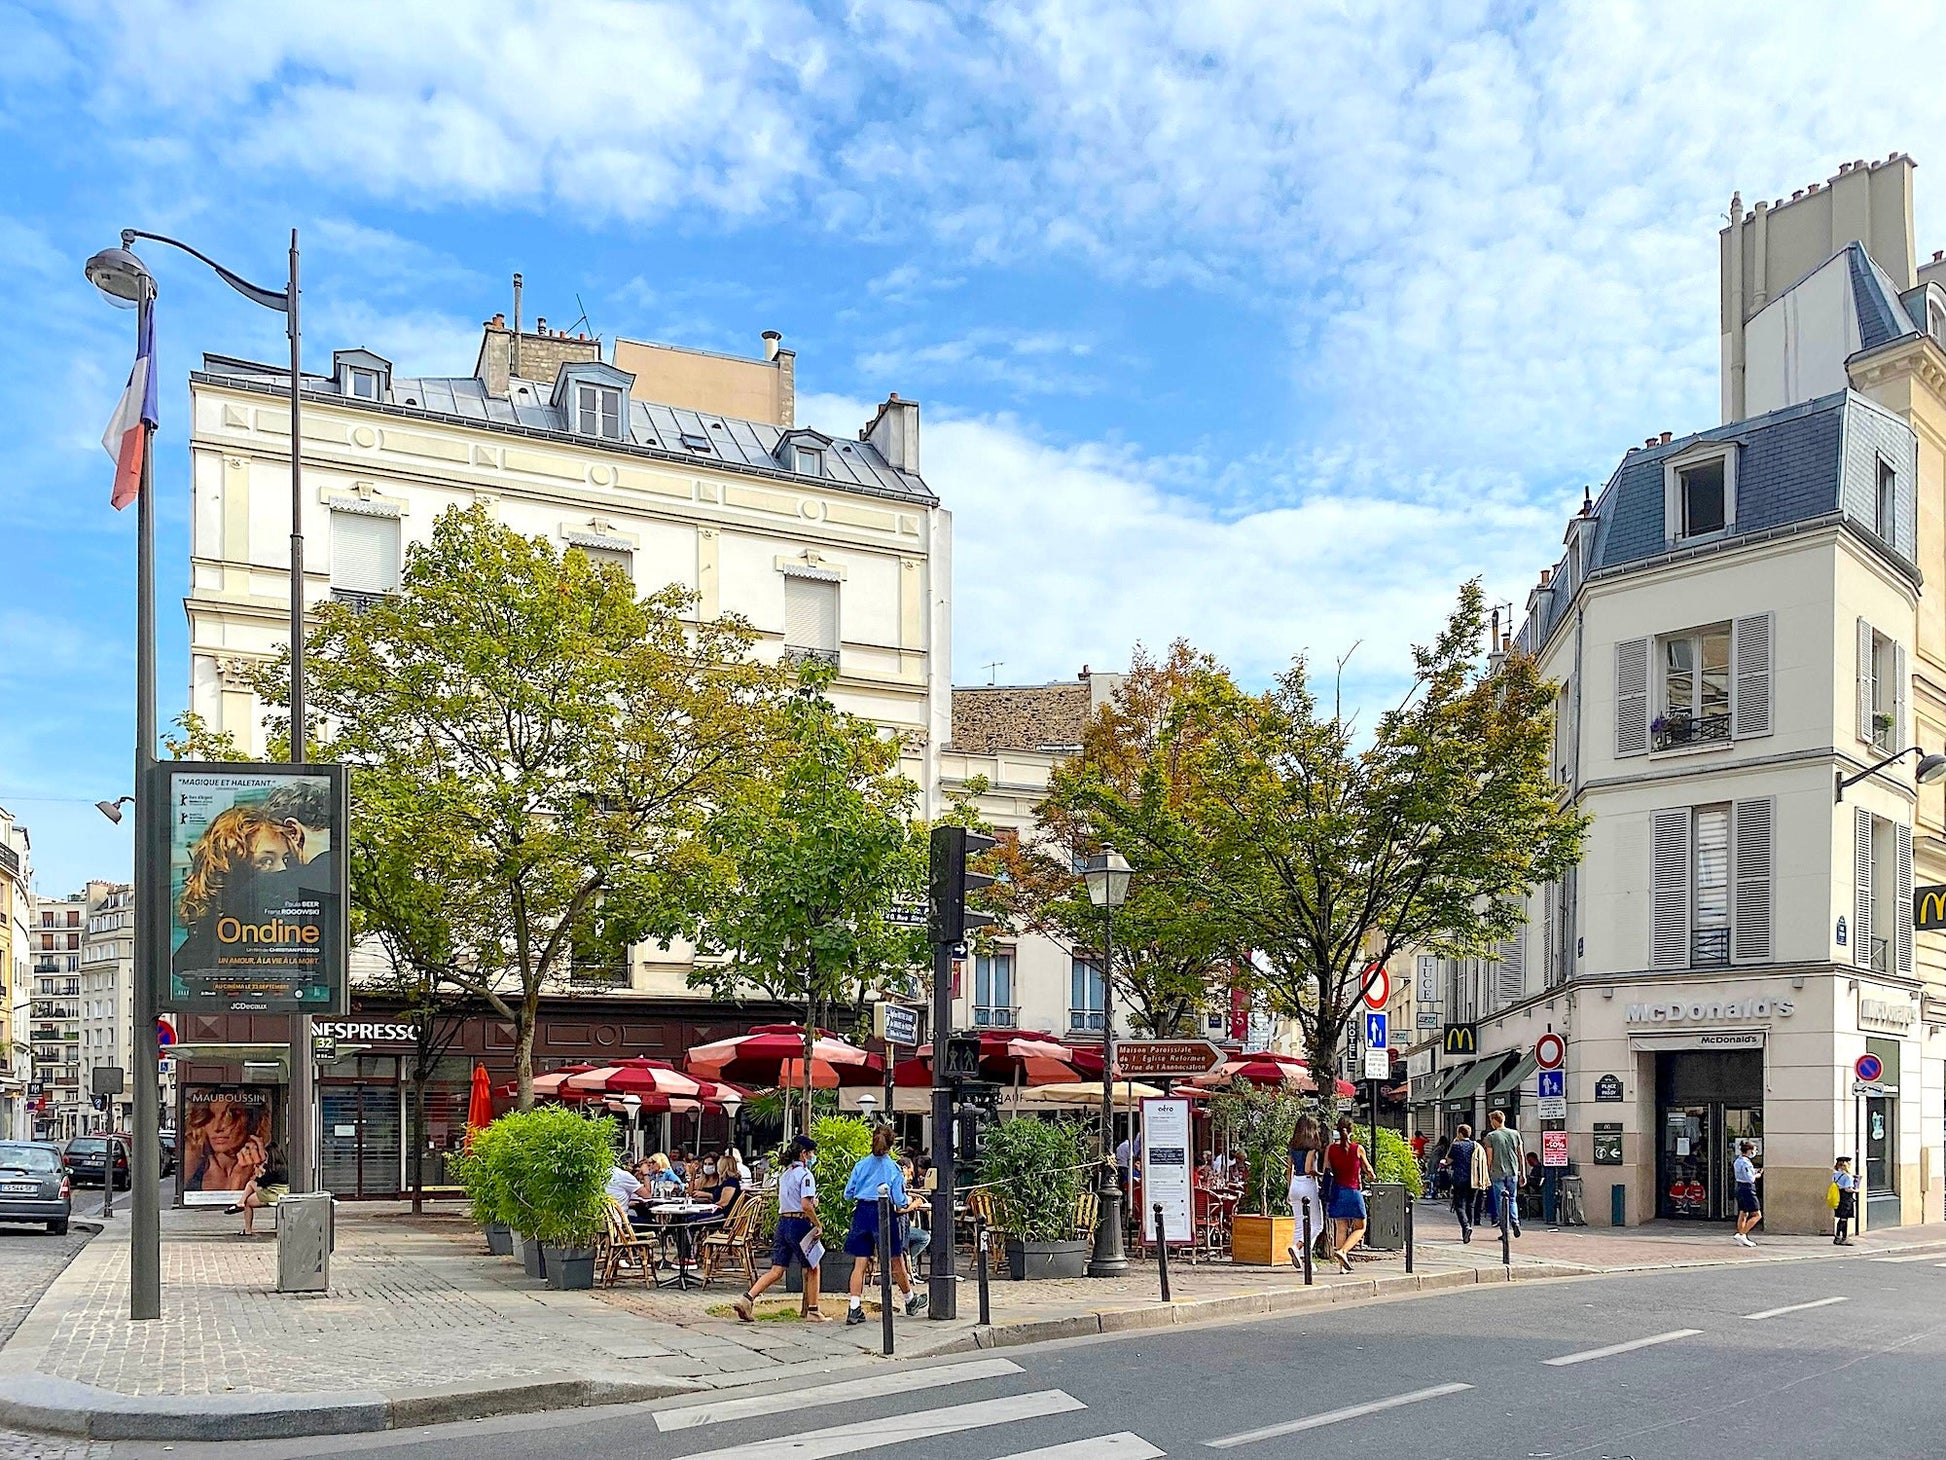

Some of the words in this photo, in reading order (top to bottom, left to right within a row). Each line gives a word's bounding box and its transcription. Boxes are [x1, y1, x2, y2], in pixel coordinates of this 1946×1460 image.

[217, 917, 320, 944] Ondine
[1422, 957, 1433, 1000] LUCE
[230, 1002, 268, 1010] JCDecaux
[1625, 999, 1796, 1024] McDonald's
[318, 1037, 334, 1048] 32
[1348, 1022, 1357, 1061] HOTEL
[1700, 1036, 1758, 1044] McDonald's
[1119, 1046, 1147, 1054] Maison
[1149, 1046, 1192, 1054] Paroissiale
[1120, 1055, 1129, 1063] de
[1120, 1063, 1129, 1071] 27
[1145, 1063, 1154, 1071] de
[192, 1093, 267, 1102] MAUBOUSSIN
